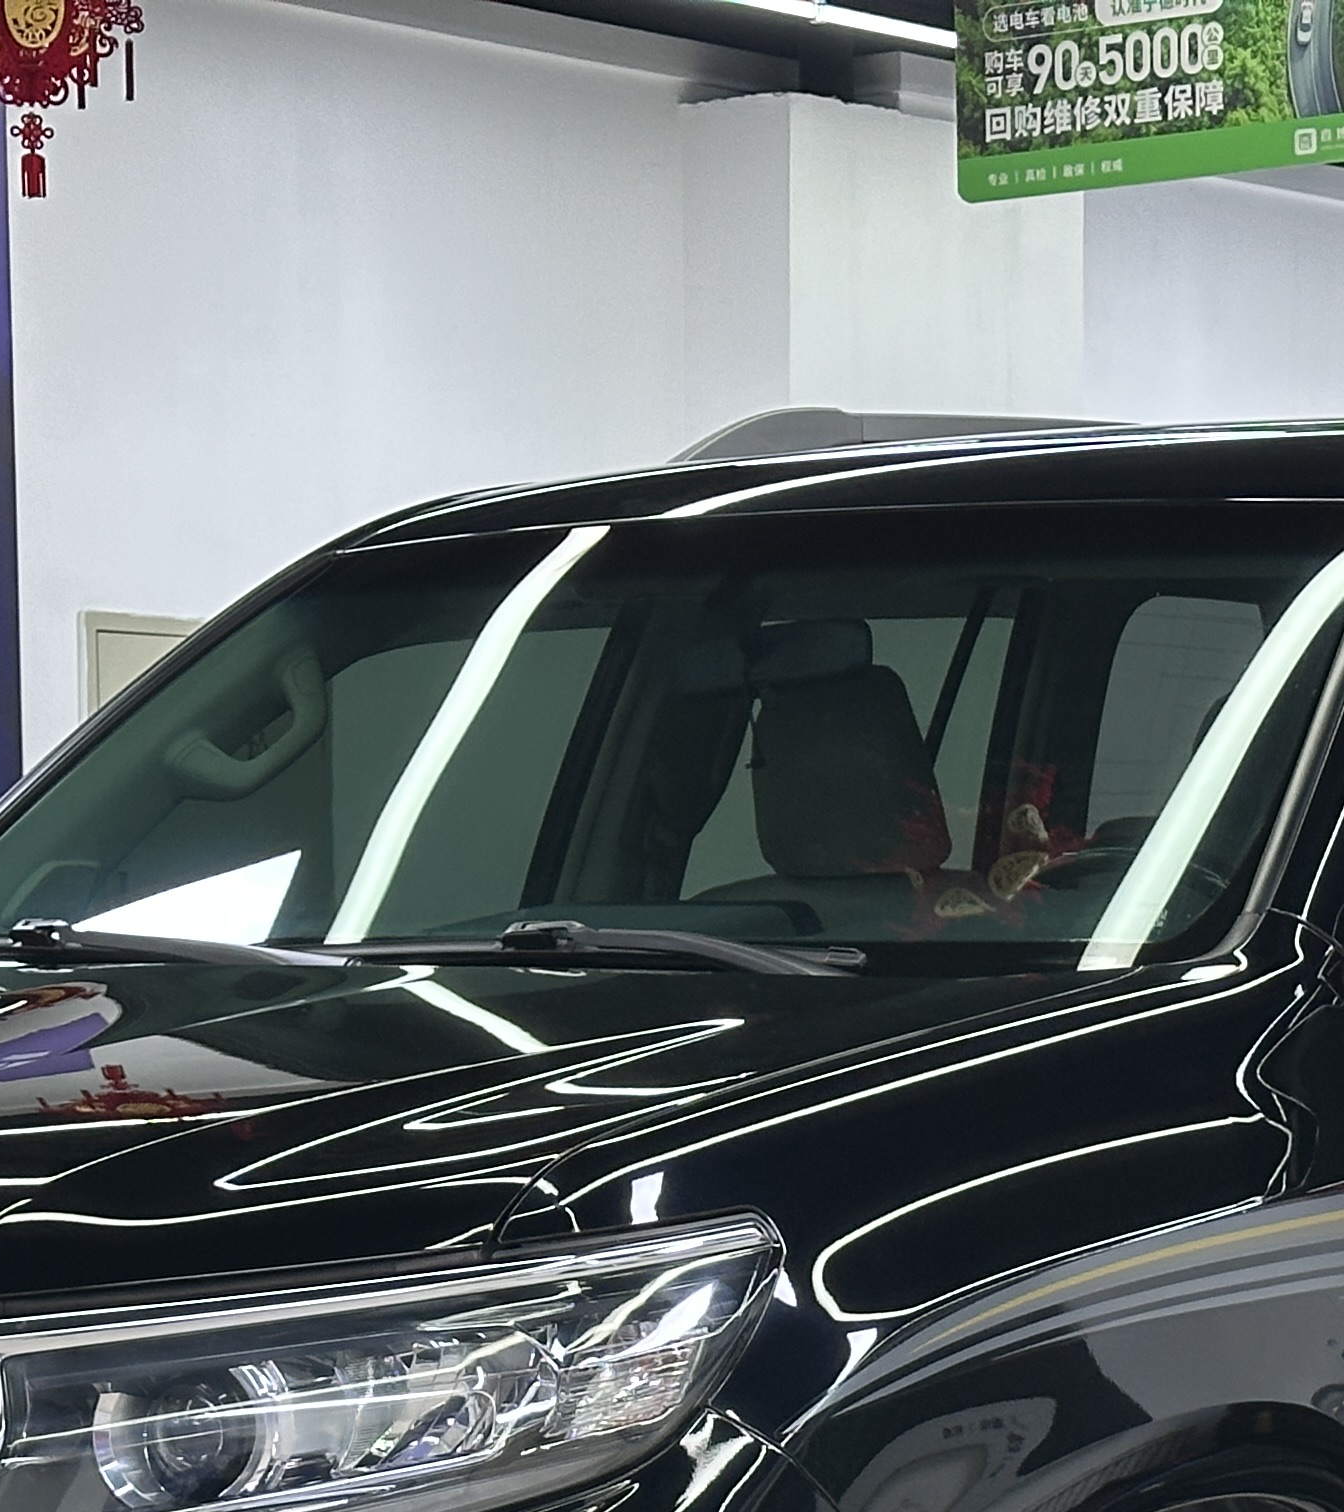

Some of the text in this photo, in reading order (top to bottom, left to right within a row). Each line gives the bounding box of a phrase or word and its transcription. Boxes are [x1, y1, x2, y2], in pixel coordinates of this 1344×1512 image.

[992, 3, 1089, 33] 选电车看电池
[984, 49, 1024, 74] 购车
[985, 73, 1025, 98] 可享
[985, 80, 1224, 142] 回购维修双重保障
